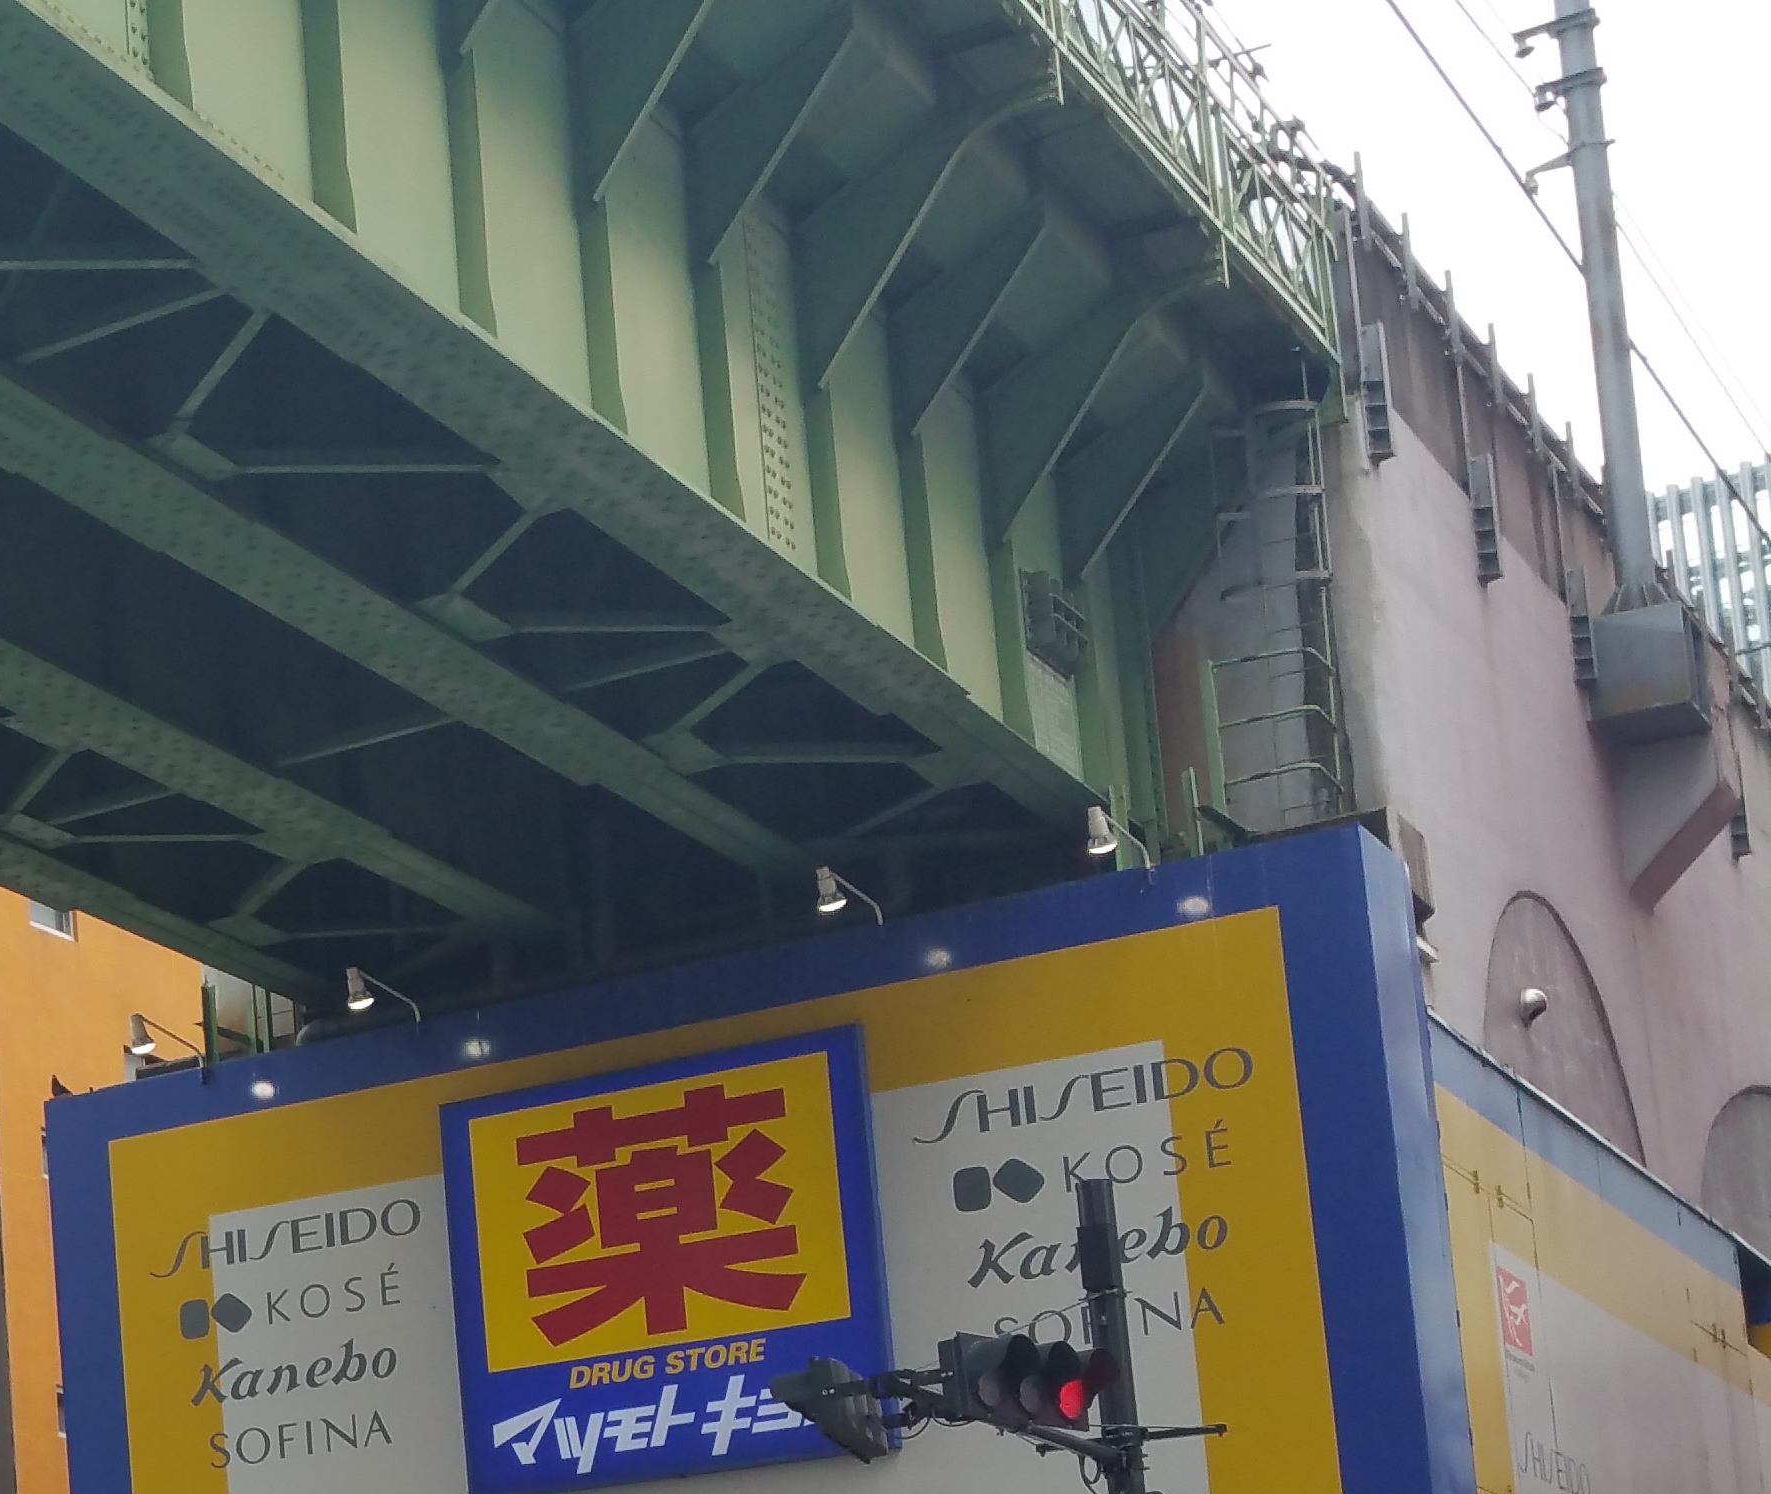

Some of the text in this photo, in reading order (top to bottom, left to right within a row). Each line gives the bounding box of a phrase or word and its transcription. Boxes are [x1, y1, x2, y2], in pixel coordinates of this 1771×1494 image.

[912, 1045, 1255, 1147] SHISEIDO
[149, 1198, 422, 1281] SHISEIDO
[515, 1083, 808, 1349] 薬
[265, 1261, 402, 1325] KOSÉ
[190, 1340, 398, 1408] Kanebo
[568, 1338, 767, 1391] DRUG STORE
[208, 1409, 394, 1471] SOFINA
